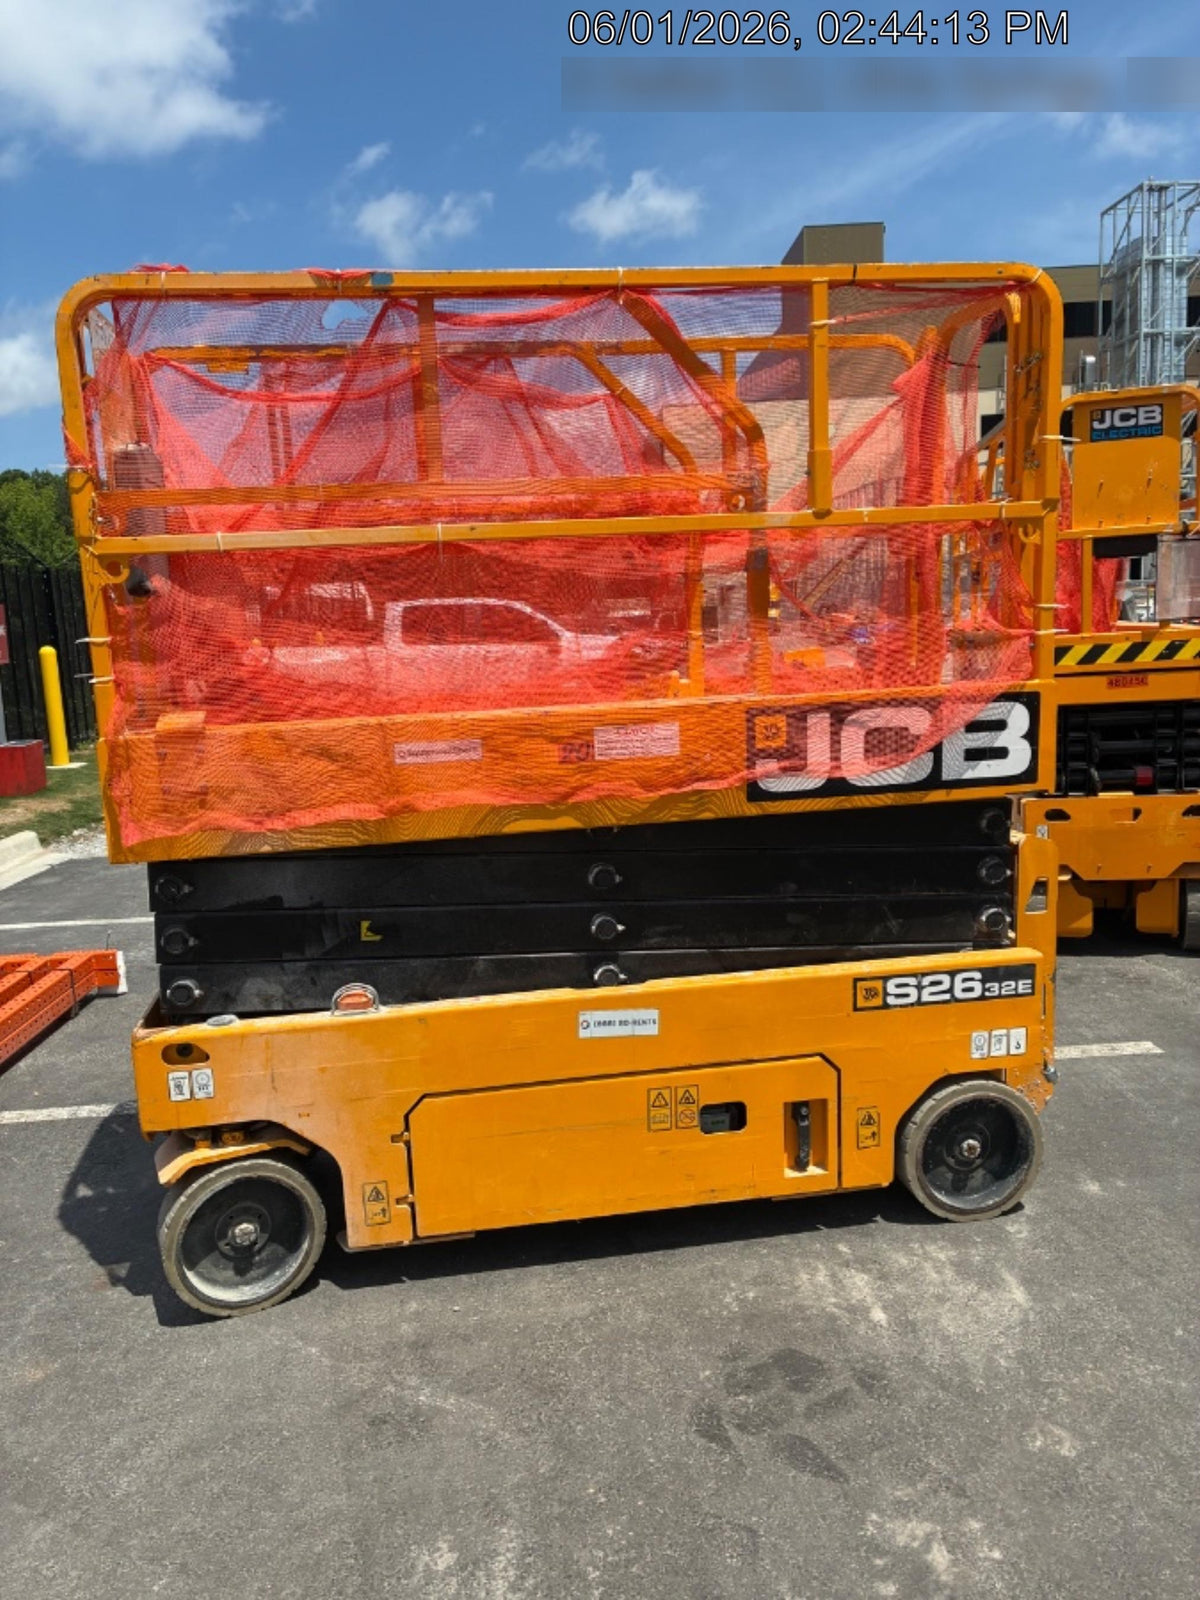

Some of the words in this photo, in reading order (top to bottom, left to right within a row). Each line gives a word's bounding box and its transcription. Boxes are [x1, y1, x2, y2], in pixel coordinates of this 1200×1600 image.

[1092, 405, 1162, 429] JCB
[1092, 426, 1162, 441] ELECTRIC
[756, 701, 1032, 793] JCB
